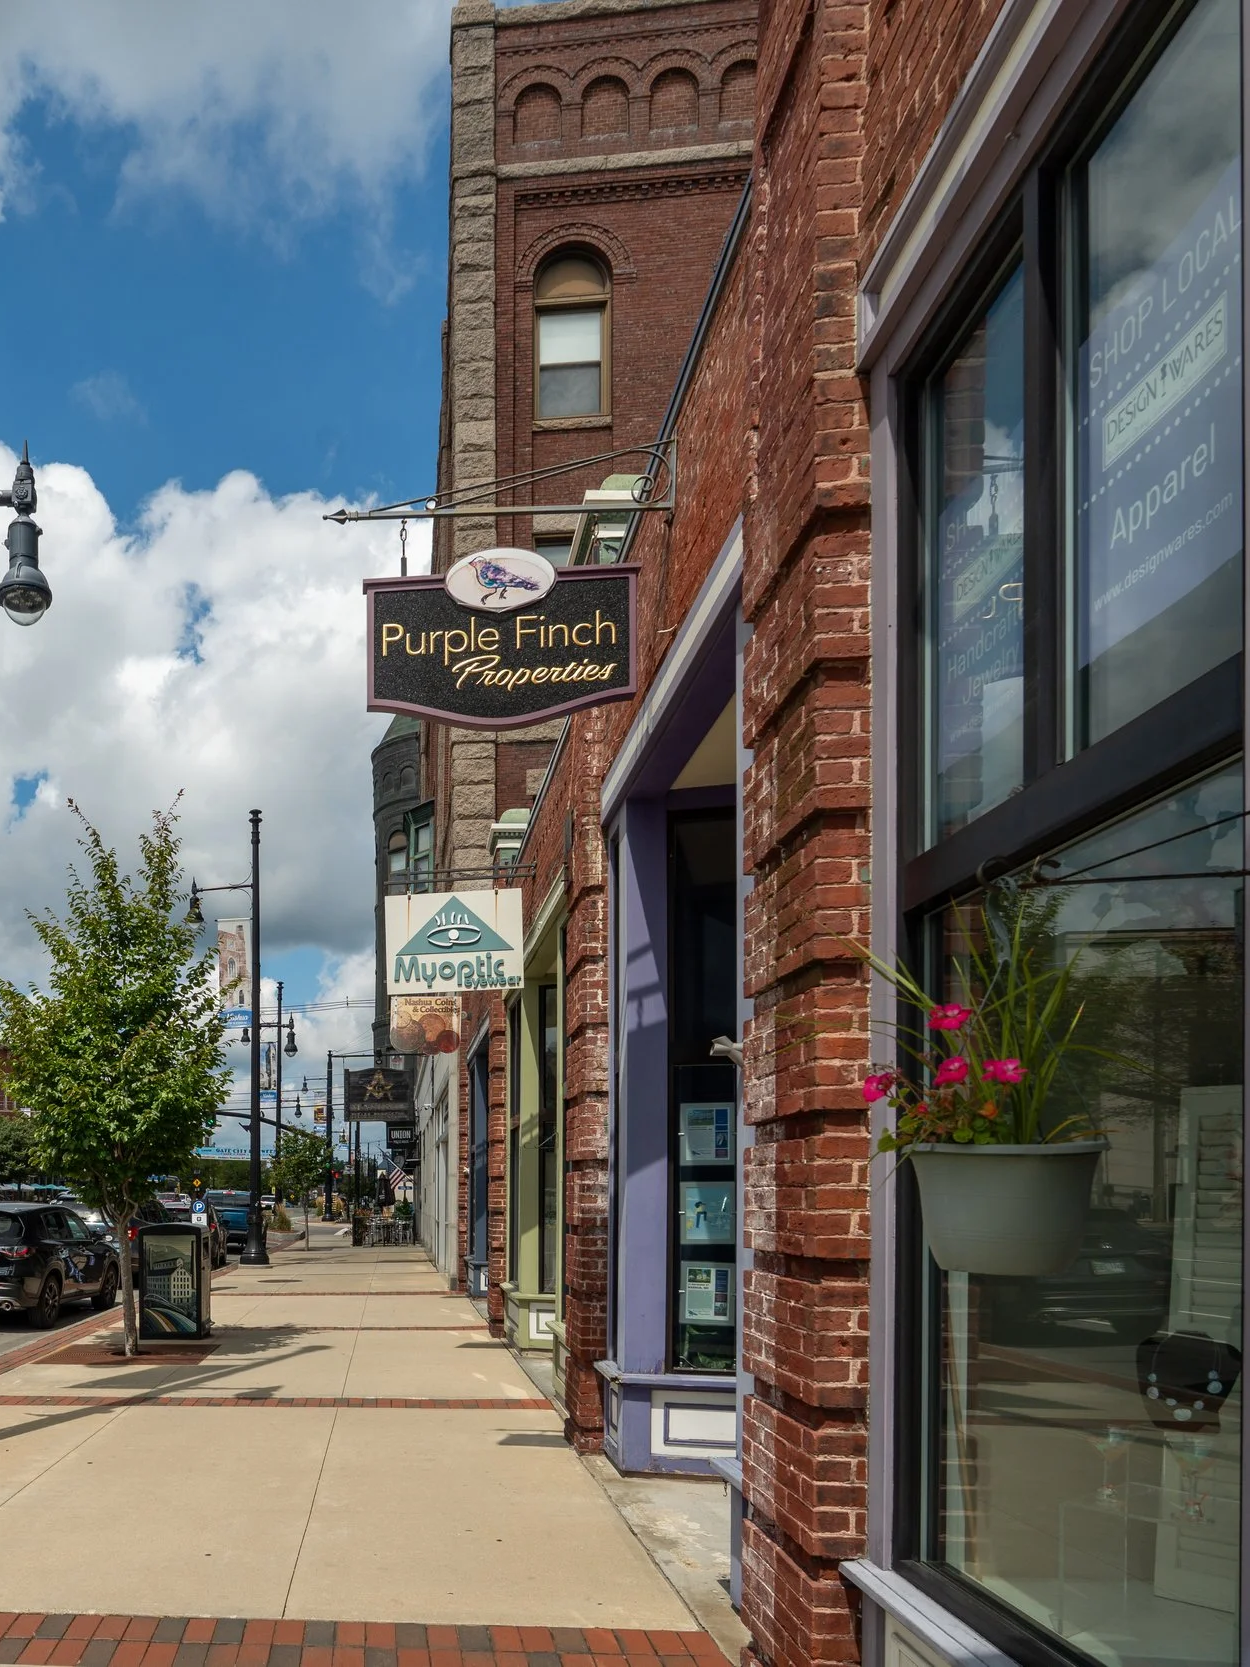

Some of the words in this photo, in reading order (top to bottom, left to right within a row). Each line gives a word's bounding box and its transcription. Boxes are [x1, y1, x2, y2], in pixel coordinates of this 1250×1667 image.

[1090, 296, 1154, 388] SHOP
[1162, 195, 1241, 314] LOCAL
[1168, 308, 1223, 382] WARES
[1110, 422, 1215, 550] Apparel
[1093, 491, 1234, 612] www.designwares.com
[382, 616, 500, 666] Purple
[516, 609, 617, 650] Finch
[451, 654, 618, 692] Properties
[963, 641, 1020, 705] Jewelry
[394, 952, 505, 989] Myoptic
[464, 975, 522, 990] eyewear
[404, 998, 432, 1006] Nashua
[390, 1130, 411, 1139] UNION
